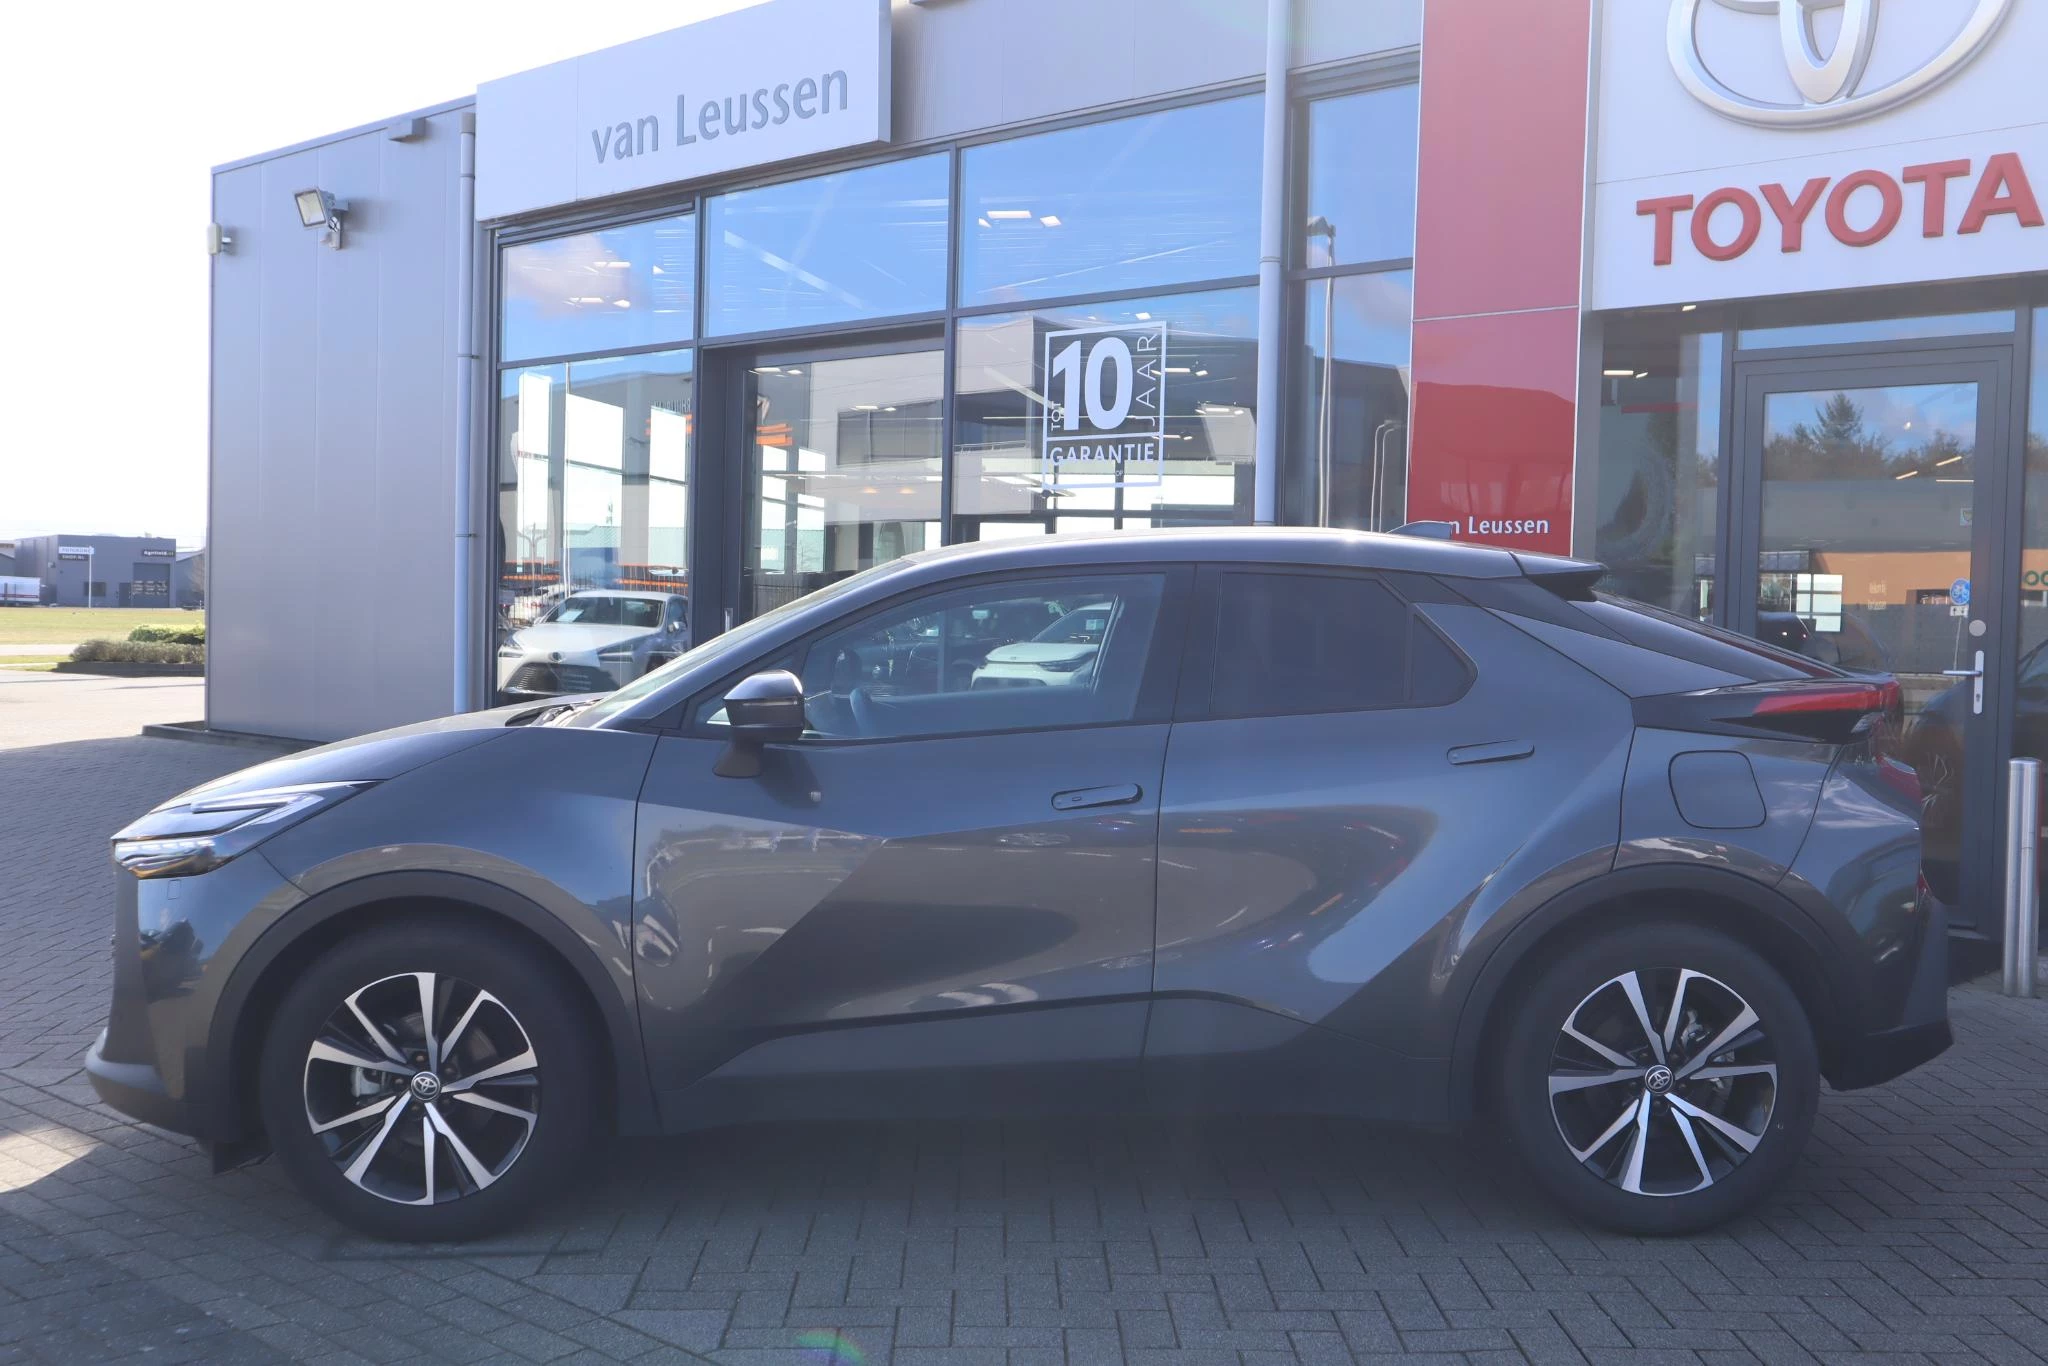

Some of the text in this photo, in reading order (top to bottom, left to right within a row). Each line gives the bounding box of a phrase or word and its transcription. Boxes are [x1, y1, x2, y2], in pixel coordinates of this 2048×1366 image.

[591, 69, 849, 164] van Leussen
[1635, 151, 2045, 266] TOYOTA
[1050, 400, 1062, 432] TOT
[1052, 336, 1133, 431] 10
[1136, 332, 1157, 427] JAAR
[1049, 443, 1155, 466] GARANTIE
[1468, 515, 1549, 534] Leussen
